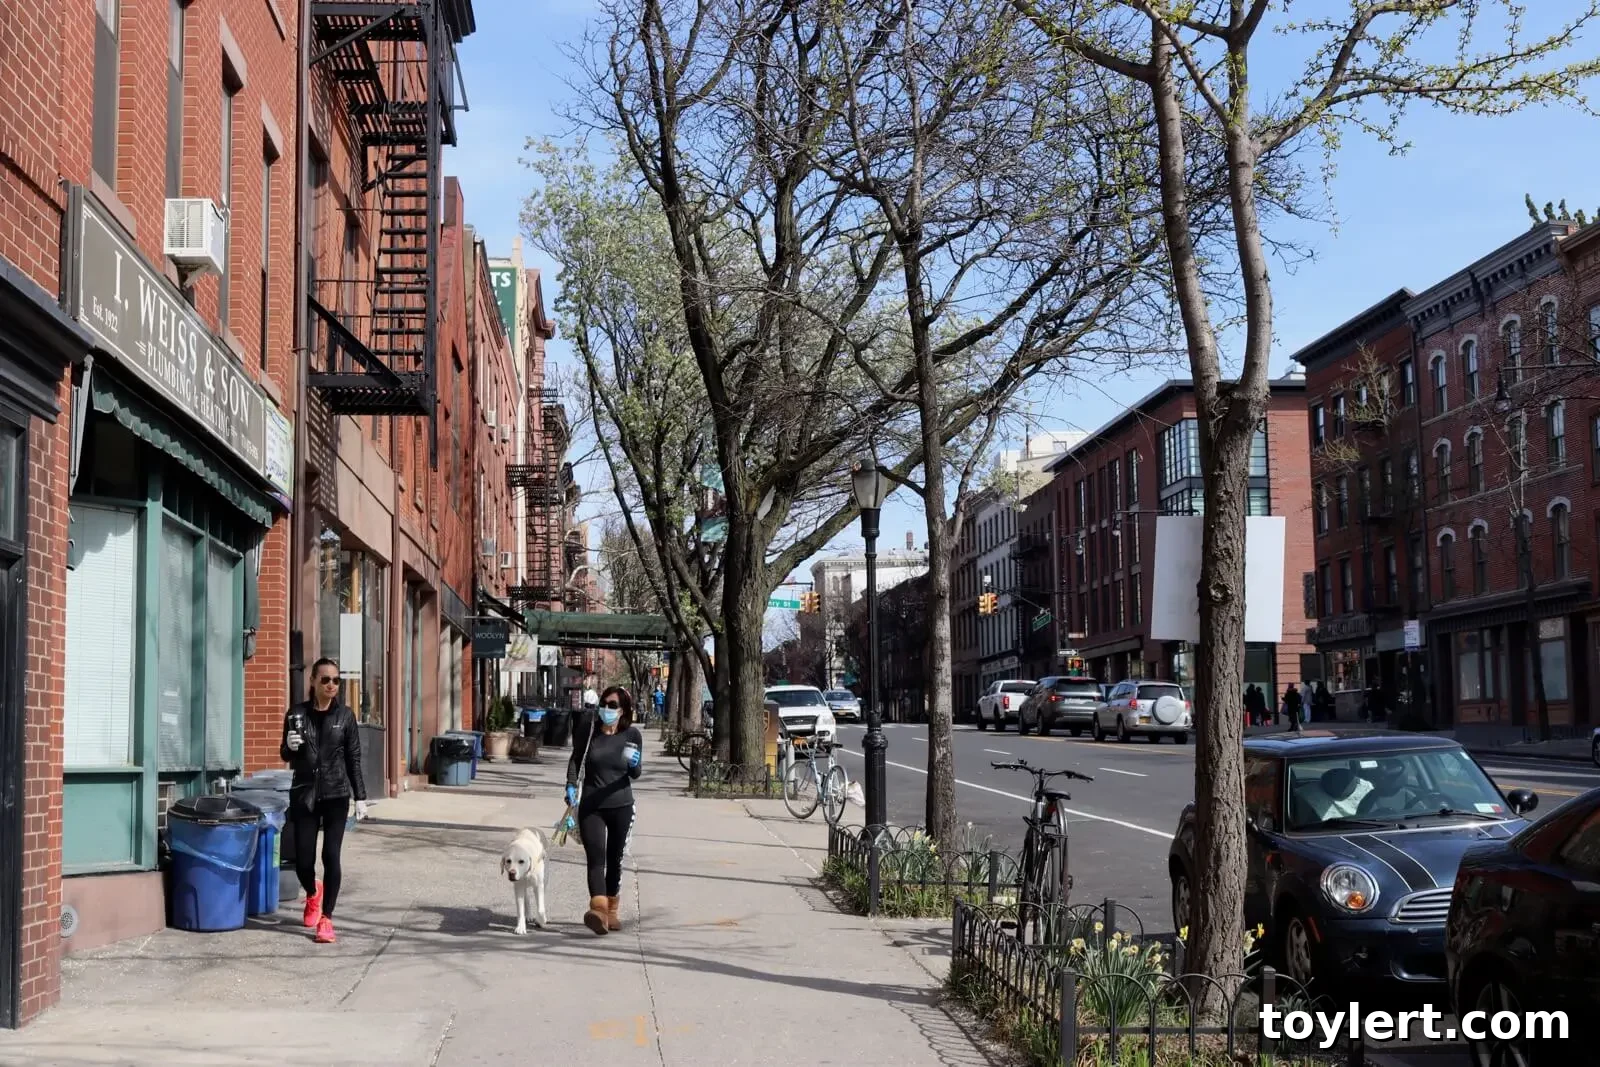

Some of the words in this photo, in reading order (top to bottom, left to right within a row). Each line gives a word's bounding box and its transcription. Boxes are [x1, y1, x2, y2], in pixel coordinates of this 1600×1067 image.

[114, 250, 129, 312] I.
[138, 274, 198, 376] WEISS
[203, 348, 216, 395] &
[221, 365, 249, 429] SON
[147, 341, 192, 402] PLUMBING
[200, 391, 230, 437] HEATING
